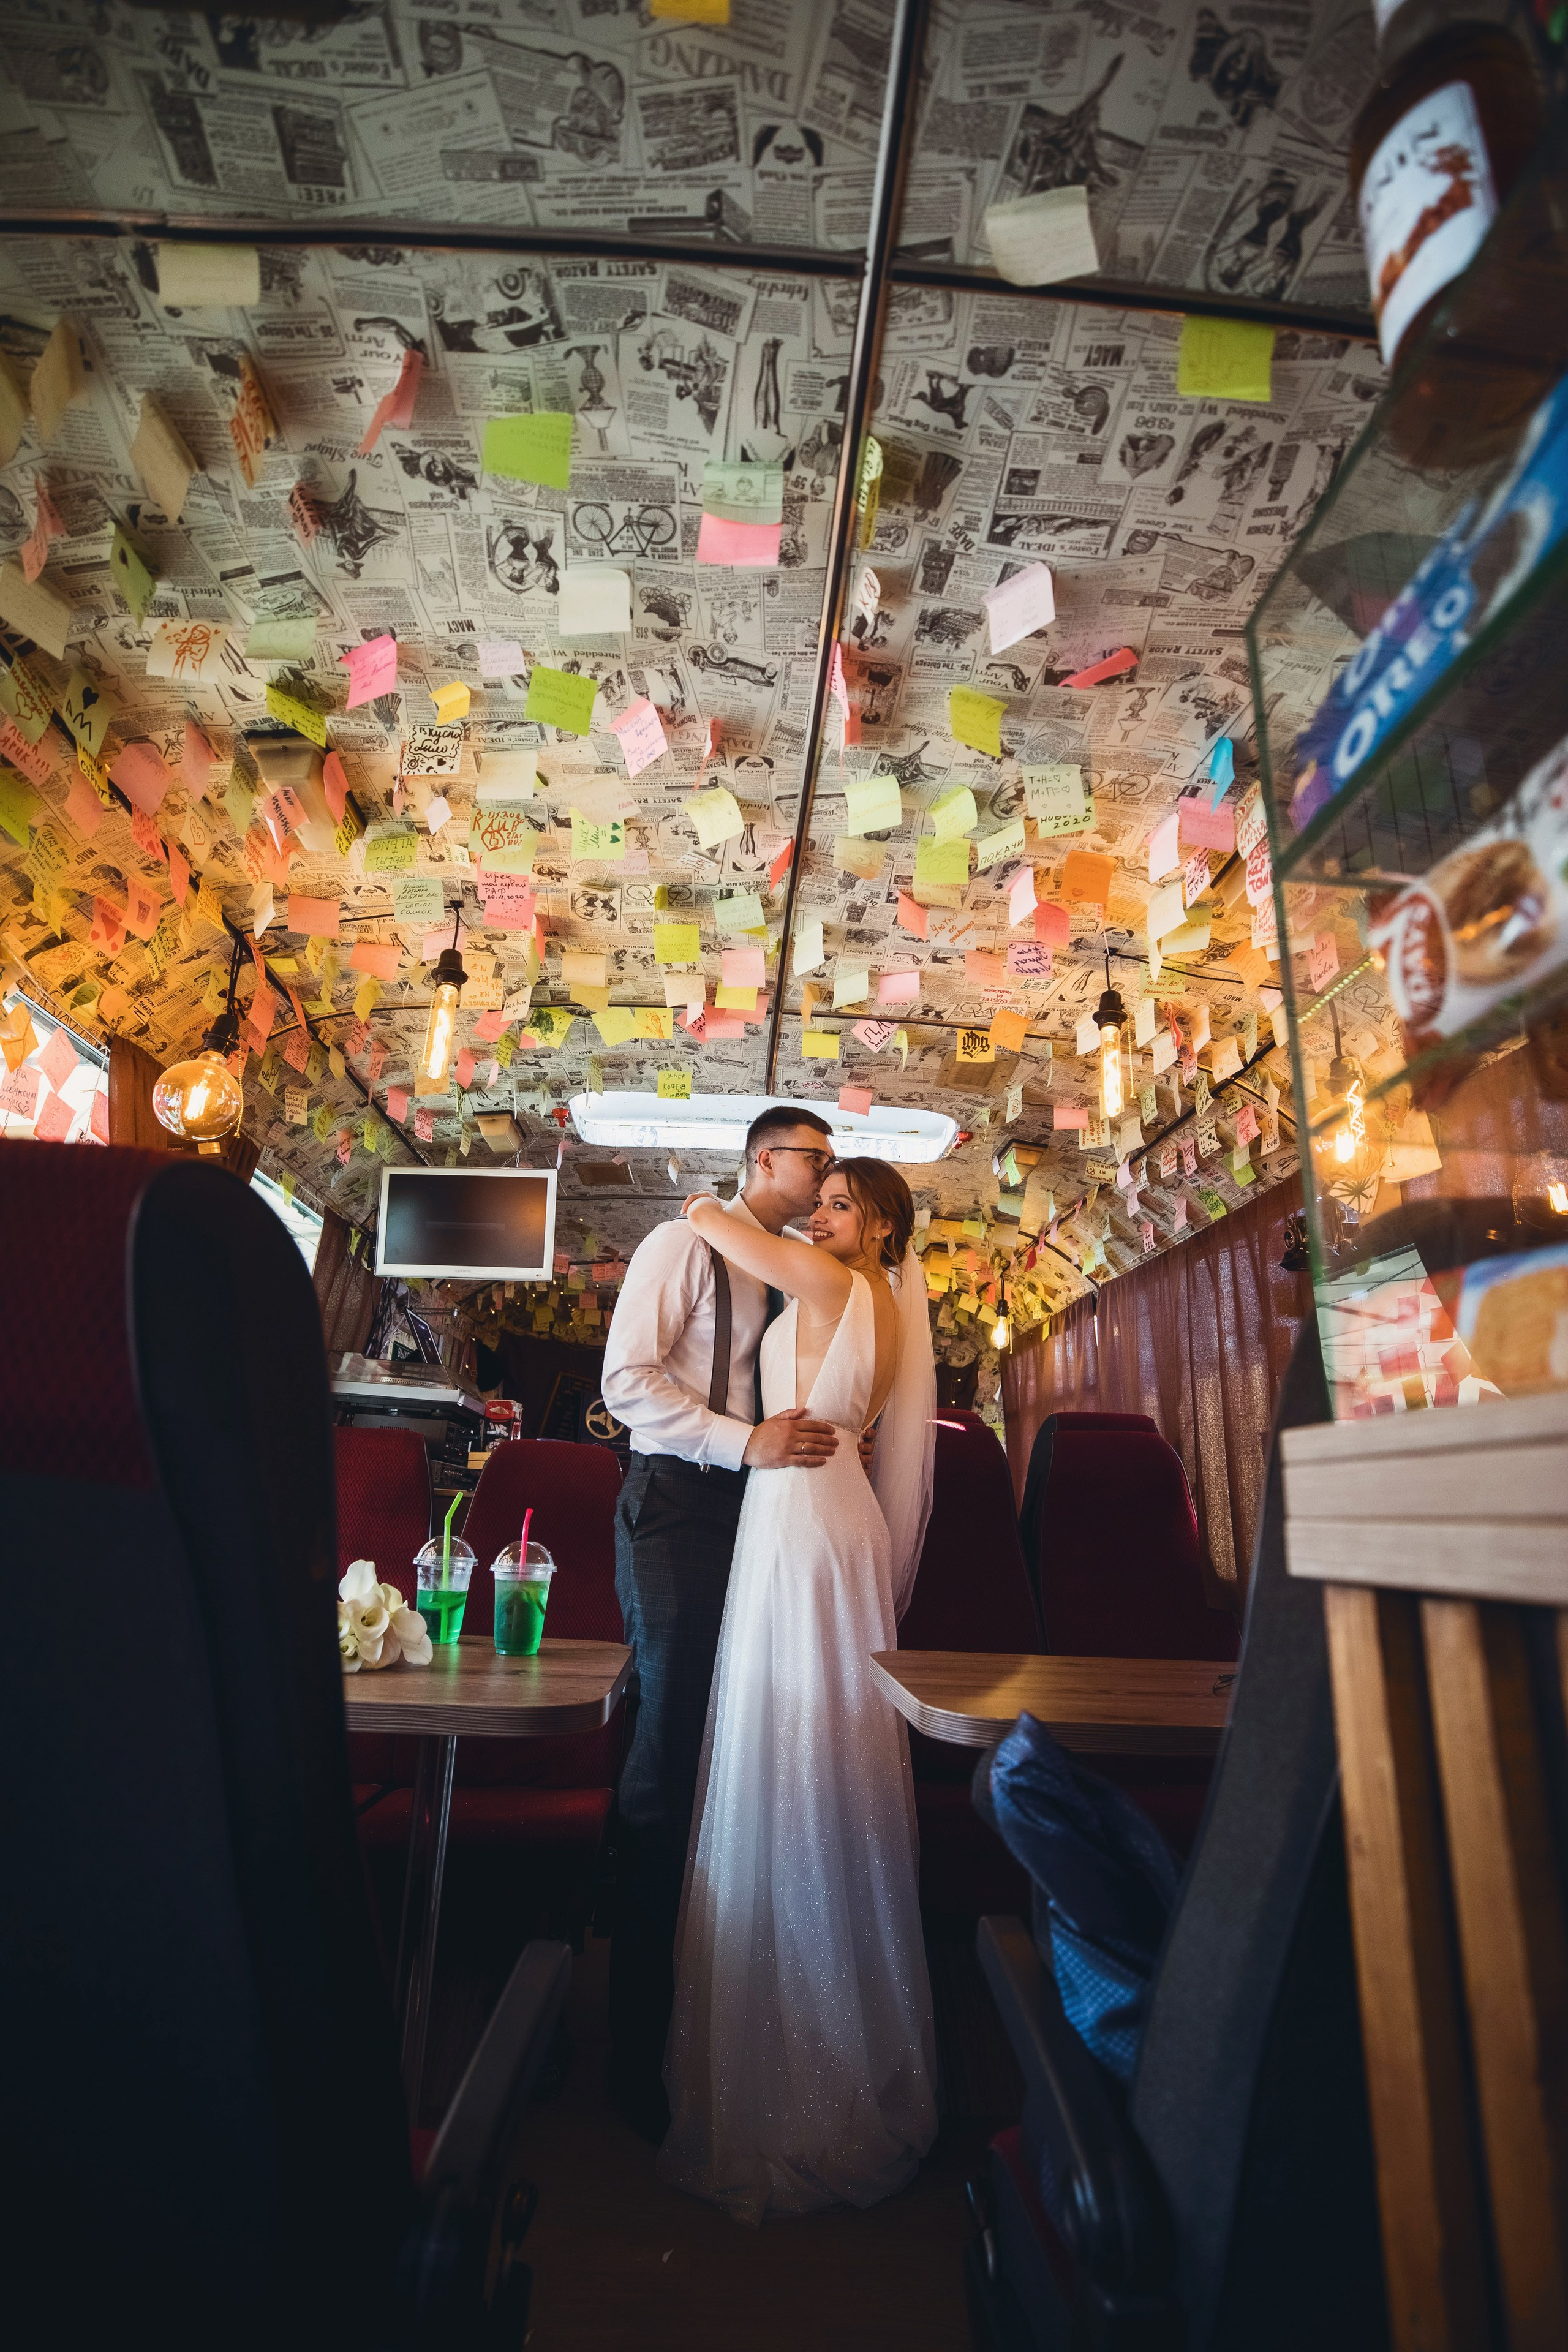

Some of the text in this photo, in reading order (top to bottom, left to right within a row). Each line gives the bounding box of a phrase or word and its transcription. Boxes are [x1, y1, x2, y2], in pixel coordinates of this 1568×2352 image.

[1225, 405, 1290, 425] Shredded
[1018, 540, 1056, 552] IDEAL
[447, 619, 476, 633] MACY
[571, 650, 622, 660] Shredded
[1185, 646, 1224, 657] SAFETY
[1334, 586, 1468, 780] OREO
[1054, 815, 1091, 829] 2020
[294, 872, 362, 882] DARLING
